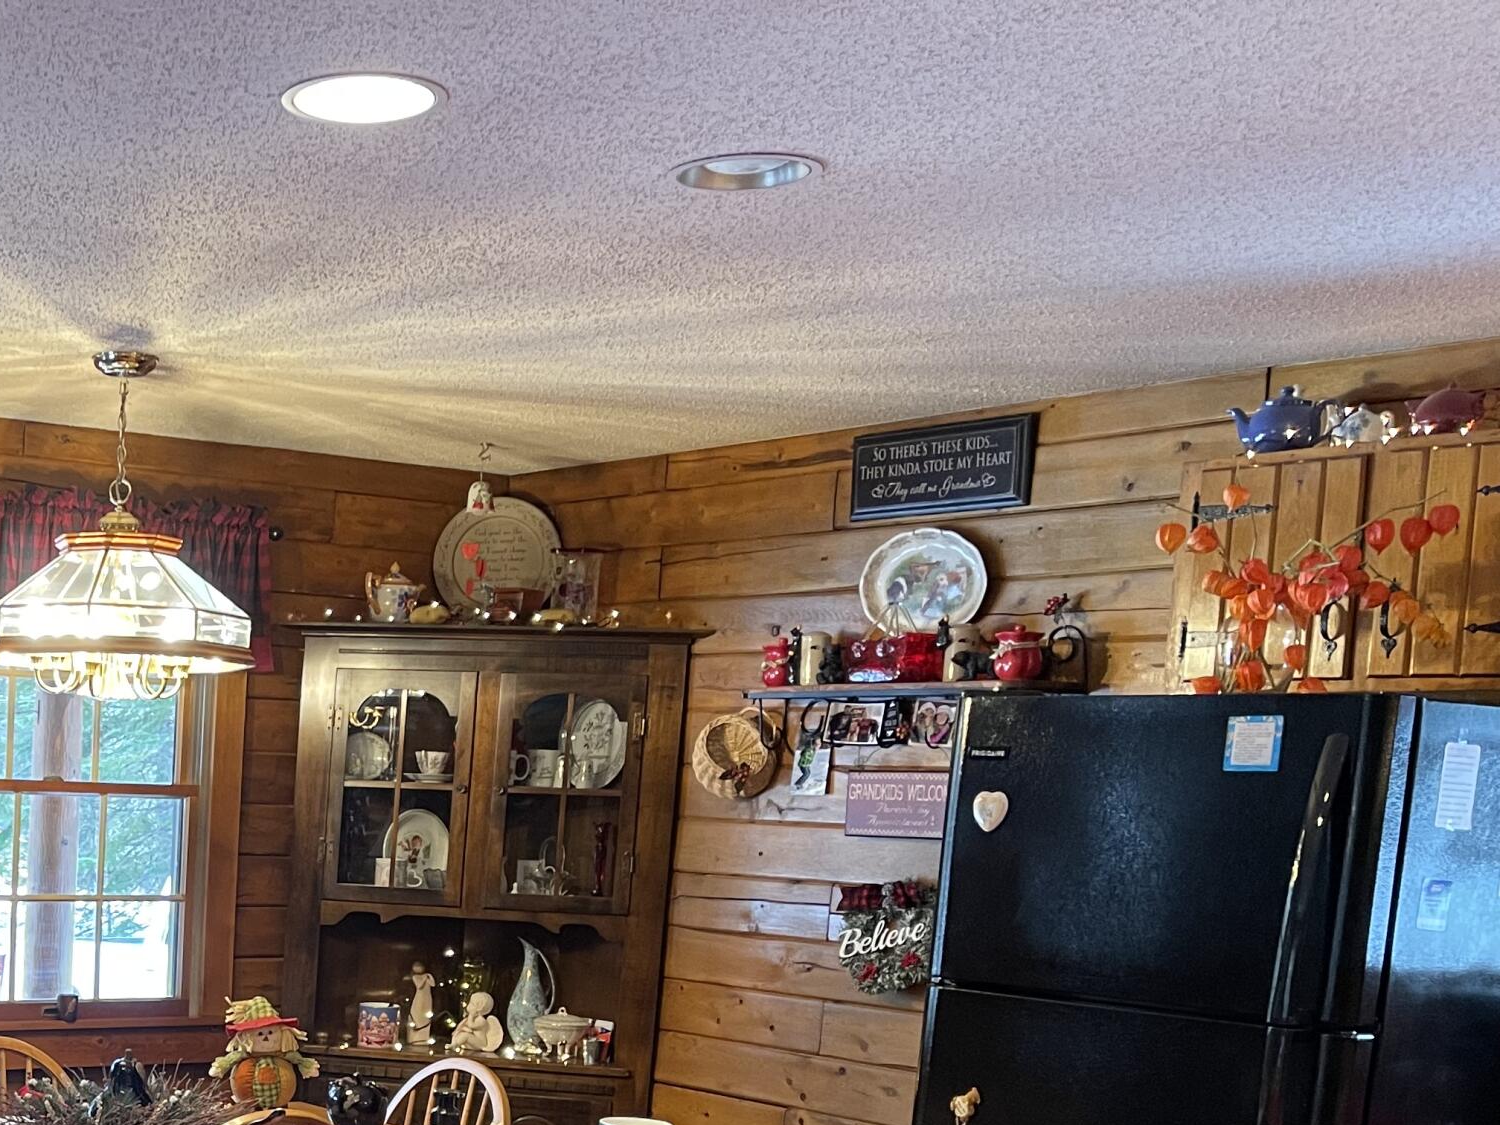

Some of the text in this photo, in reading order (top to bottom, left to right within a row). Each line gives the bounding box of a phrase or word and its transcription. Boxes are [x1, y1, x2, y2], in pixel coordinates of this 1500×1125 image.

[873, 447, 887, 462] SO
[889, 441, 928, 460] THERE'S
[932, 439, 963, 455] THESE
[860, 450, 1012, 480] THEY KINDA STOLE MY HEART
[885, 481, 908, 502] They
[849, 783, 904, 801] GRANDKIDS
[838, 919, 925, 959] Believe
